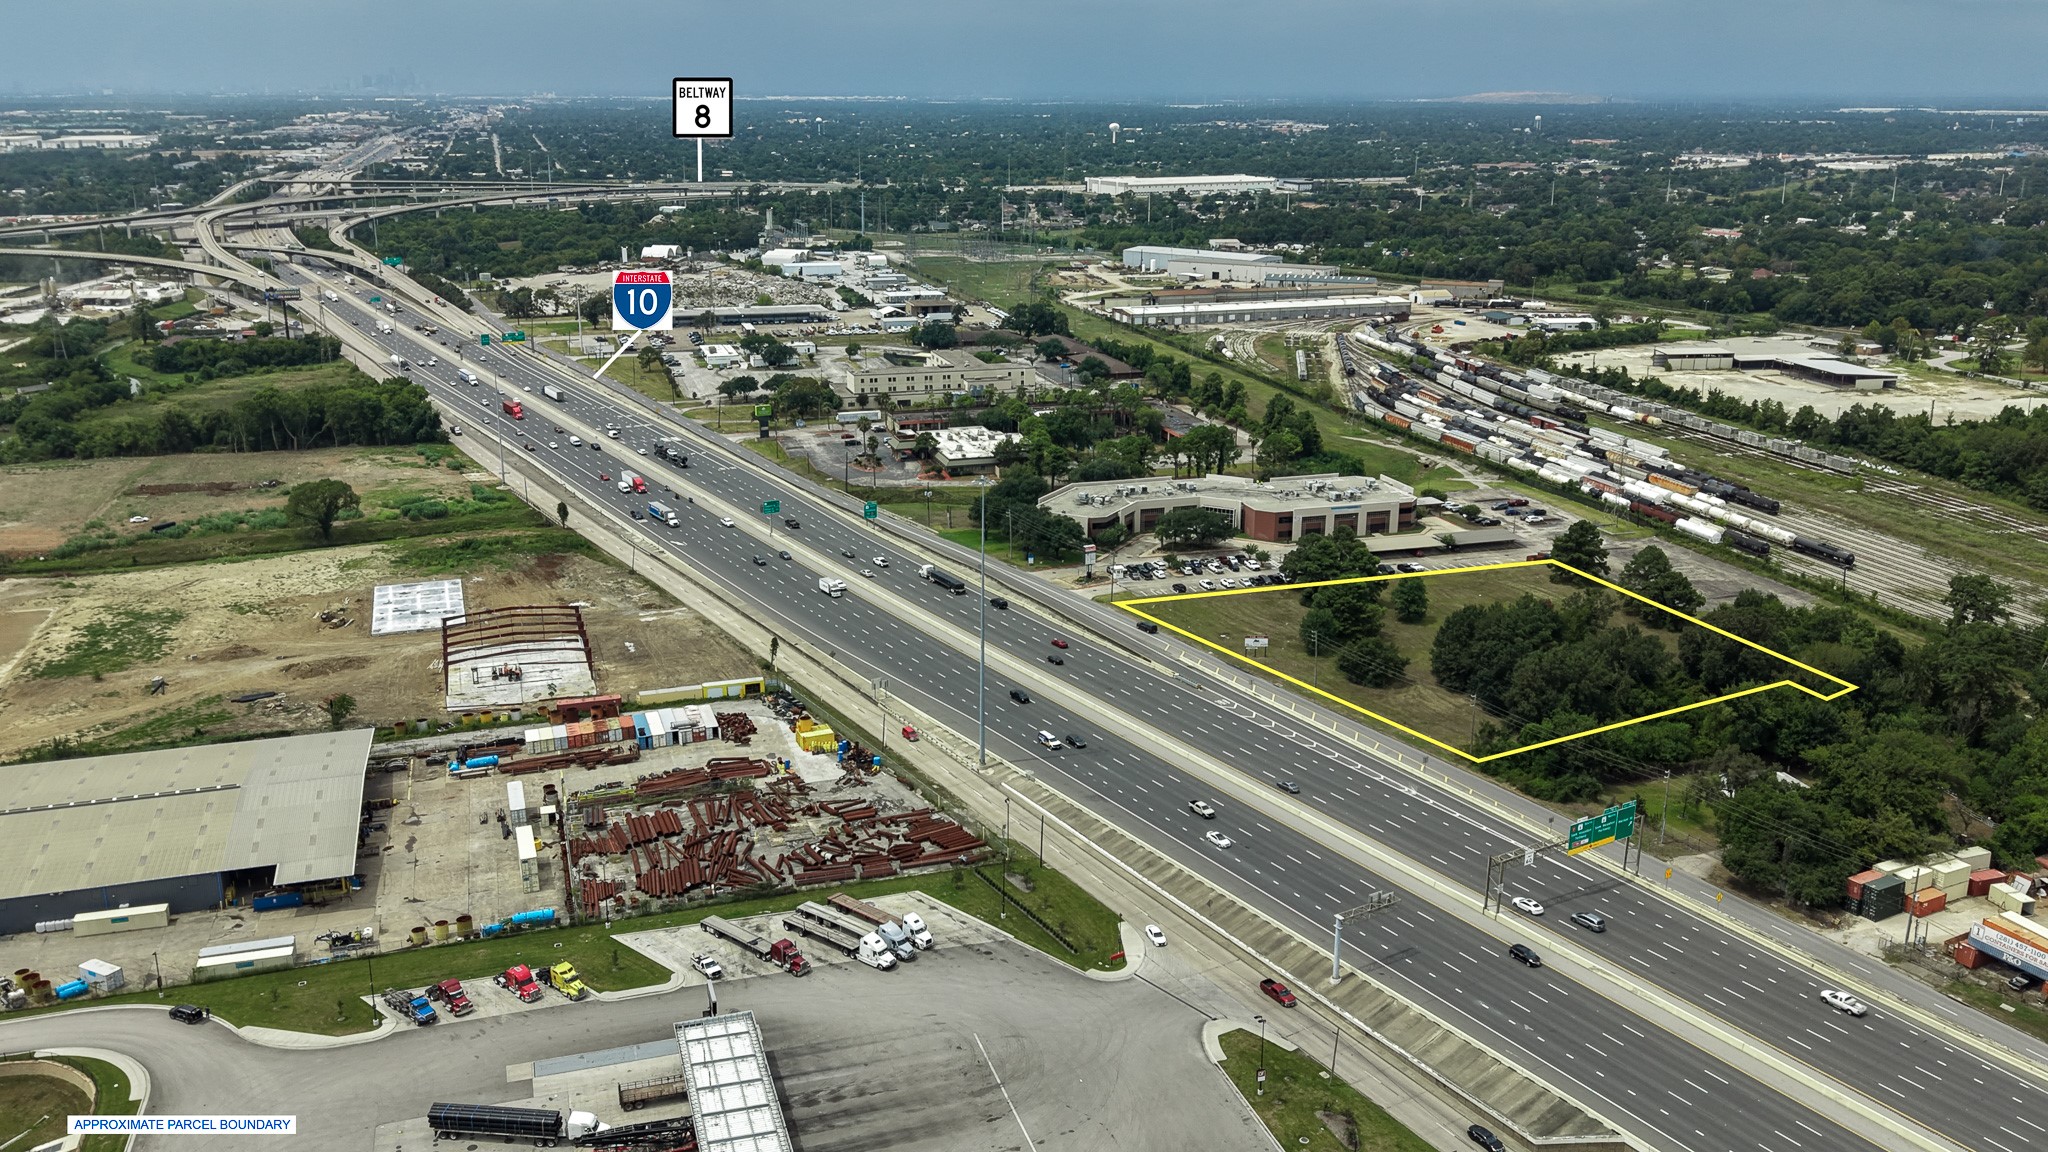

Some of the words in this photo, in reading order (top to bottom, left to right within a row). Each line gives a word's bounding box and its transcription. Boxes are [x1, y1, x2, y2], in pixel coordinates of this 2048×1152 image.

[1996, 933, 2014, 946] (281)
[1984, 935, 2025, 957] CONTAINERS
[2025, 953, 2039, 963] FOR
[2039, 959, 2048, 968] SA
[2015, 942, 2047, 960] 457-1100
